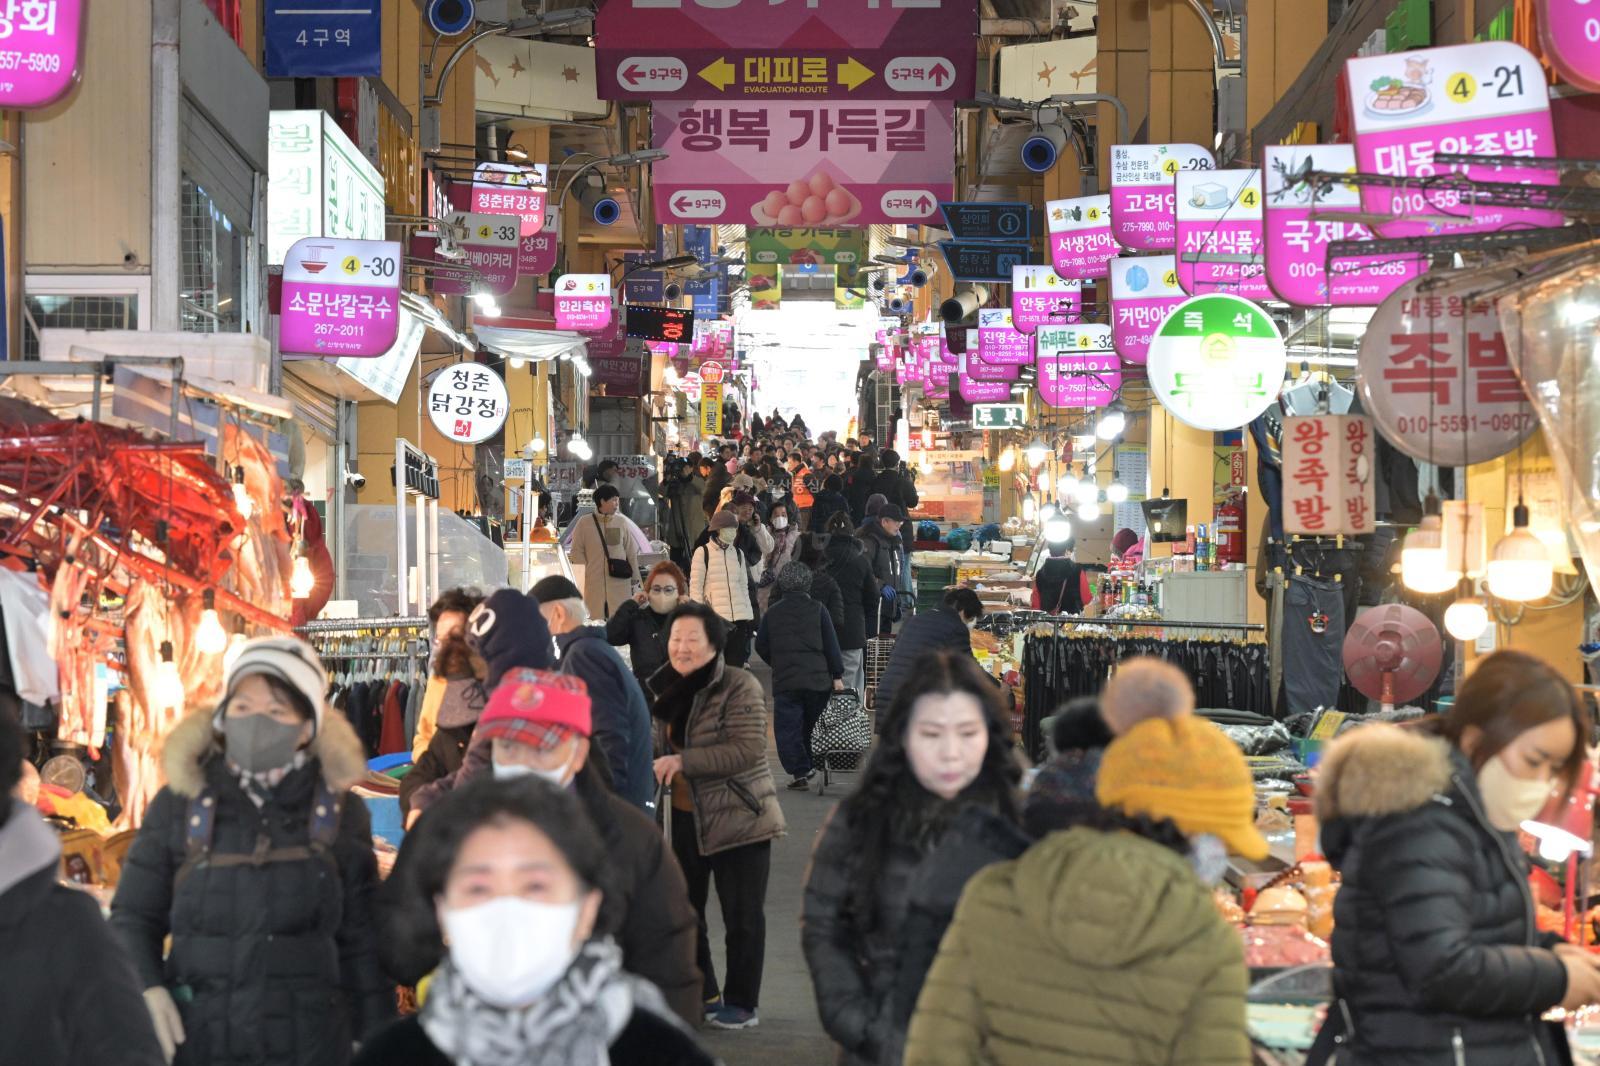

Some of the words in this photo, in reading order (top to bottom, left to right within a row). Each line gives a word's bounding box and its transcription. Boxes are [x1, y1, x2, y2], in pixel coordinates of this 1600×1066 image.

[650, 68, 682, 80] 9구역
[744, 57, 828, 84] 대피로
[891, 68, 925, 80] 5구역
[678, 109, 770, 152] 행복
[789, 109, 926, 152] 가득길
[479, 193, 540, 211] 청춘닭강정
[695, 199, 721, 209] 9구역
[886, 199, 913, 209] 6구역
[288, 291, 392, 319] 소문난칼국수
[314, 323, 364, 336] 267-2011
[1040, 330, 1077, 349] 슈퍼푸드
[1384, 331, 1530, 406] 족발
[452, 370, 490, 392] 청춘
[431, 393, 496, 418] 닭강정
[1398, 414, 1532, 434] 010-5591-0907
[1233, 453, 1244, 478] 소화기
[1292, 418, 1332, 531] 왕족발
